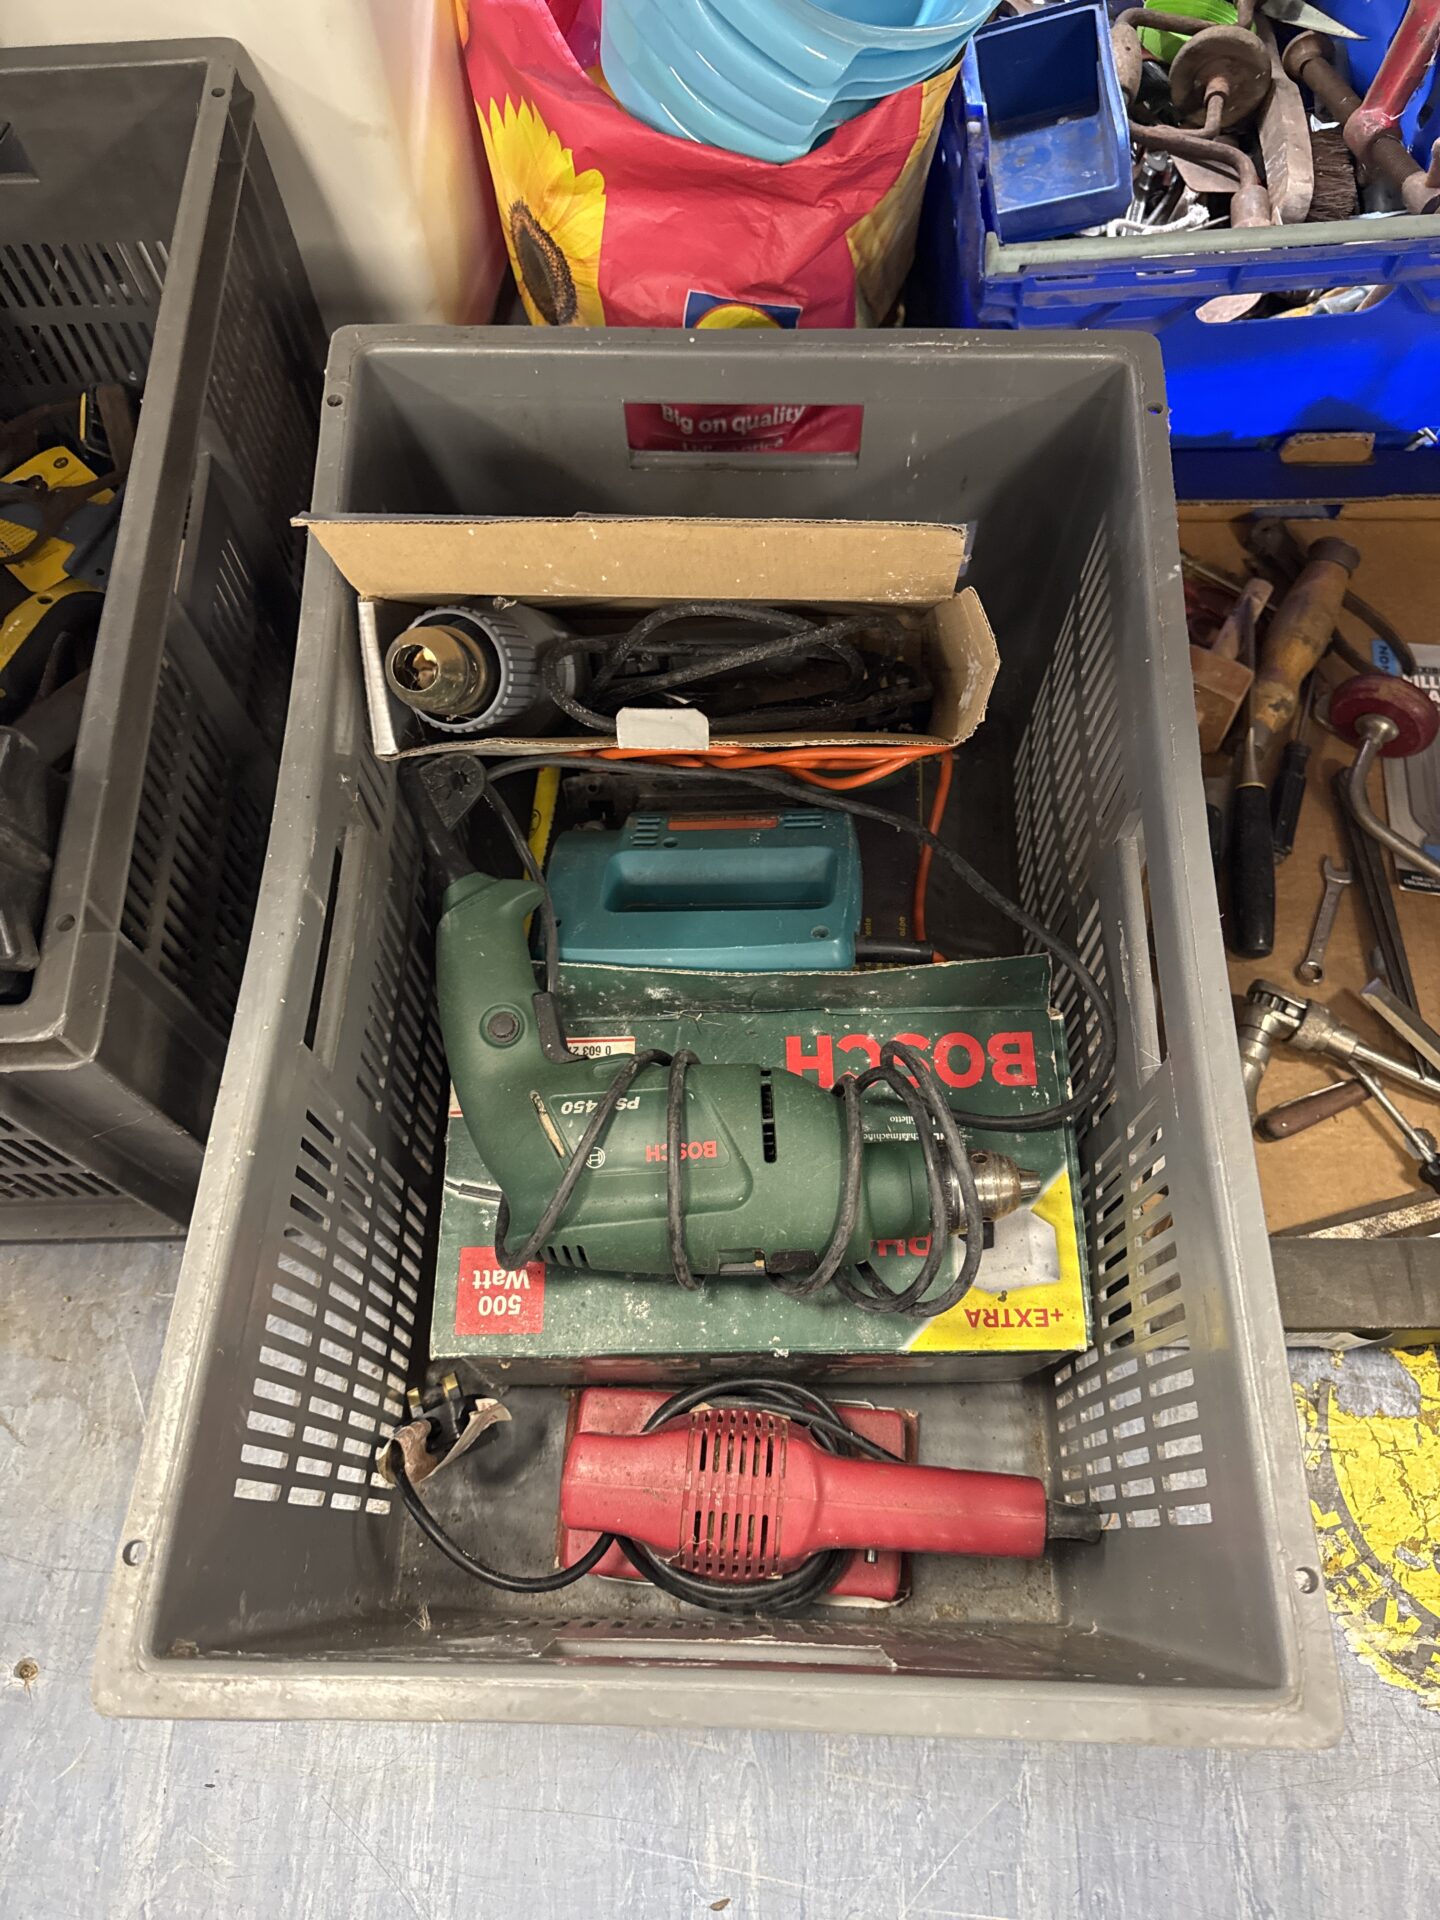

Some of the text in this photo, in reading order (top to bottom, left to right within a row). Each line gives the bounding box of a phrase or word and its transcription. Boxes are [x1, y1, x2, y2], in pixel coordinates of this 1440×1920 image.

[662, 405, 806, 435] Big on quality
[567, 1046, 612, 1056] 0 603 2
[785, 1032, 1038, 1089] BOSCH
[561, 1100, 598, 1114] 450
[472, 1269, 531, 1290] Watt
[478, 1293, 522, 1316] 500
[963, 1307, 1064, 1328] +EXTRA
